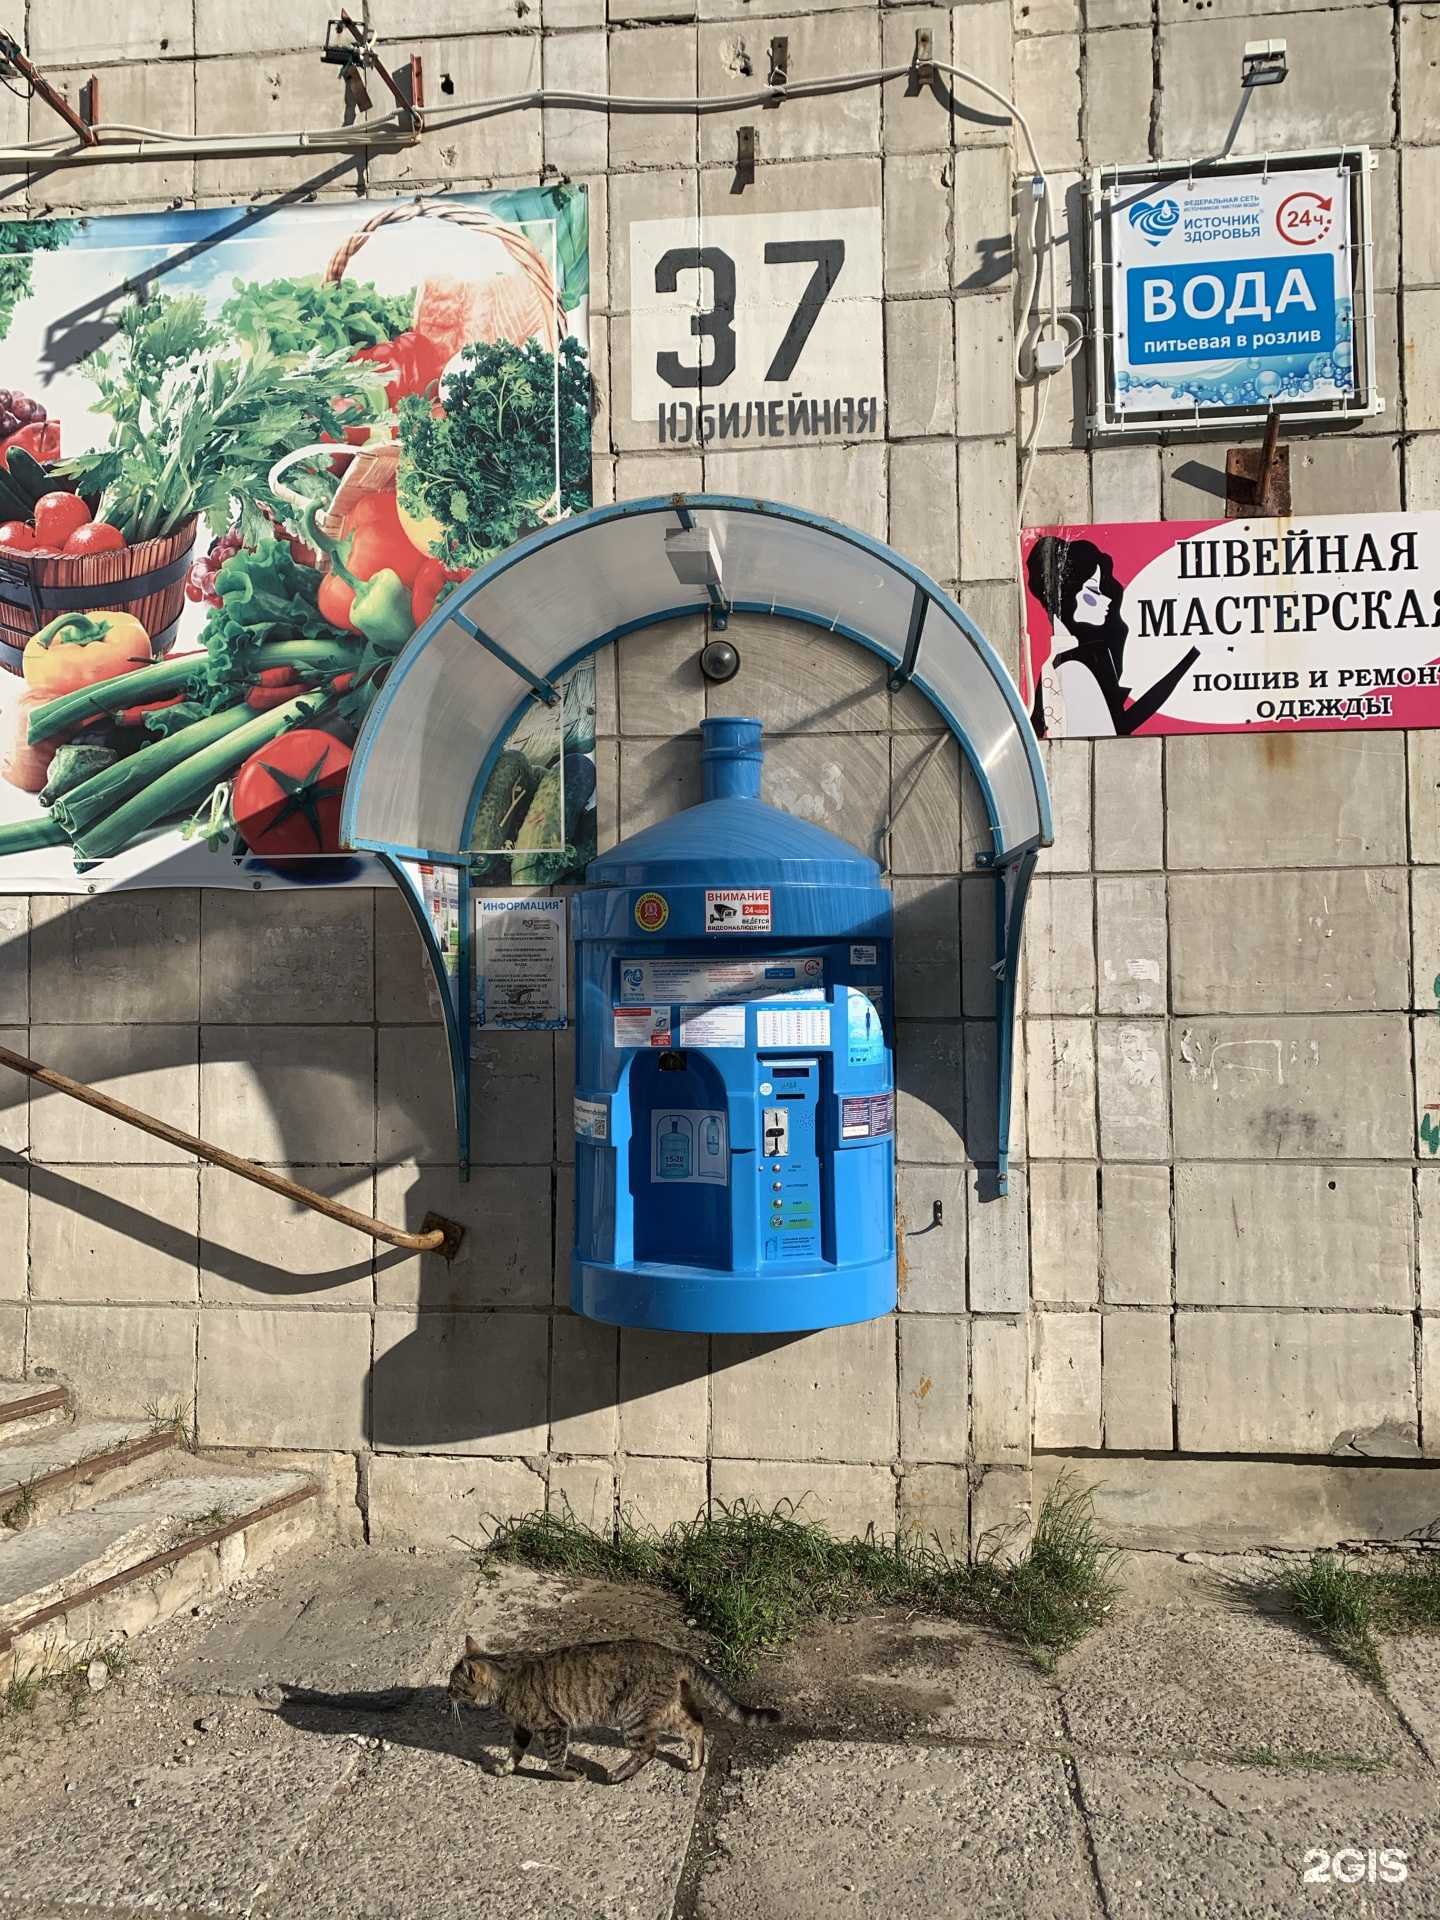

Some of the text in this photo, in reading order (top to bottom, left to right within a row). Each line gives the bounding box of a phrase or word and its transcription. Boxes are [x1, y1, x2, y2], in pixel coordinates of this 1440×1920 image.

[1184, 196, 1239, 206] ФЕДЕРАЛЬНАЯ
[1184, 214, 1259, 230] ИСТОЧНИК
[1184, 227, 1261, 243] ЗДОРОВЬЯ
[1143, 268, 1317, 325] ВОДА
[655, 239, 845, 388] 37
[1144, 329, 1321, 353] питьевая в розлив
[658, 392, 877, 443] ЮБИЛЕЙНАЯ
[1176, 529, 1419, 580] ШВЕЙНАЯ
[1193, 666, 1440, 692] ПОШИВ И РЕМОН
[1257, 696, 1391, 720] ОДЕЖДЫ
[483, 901, 560, 911] ИНФОРМАЦИЯ
[707, 892, 769, 902] ВНИМАНИЕ
[744, 906, 754, 914] 24
